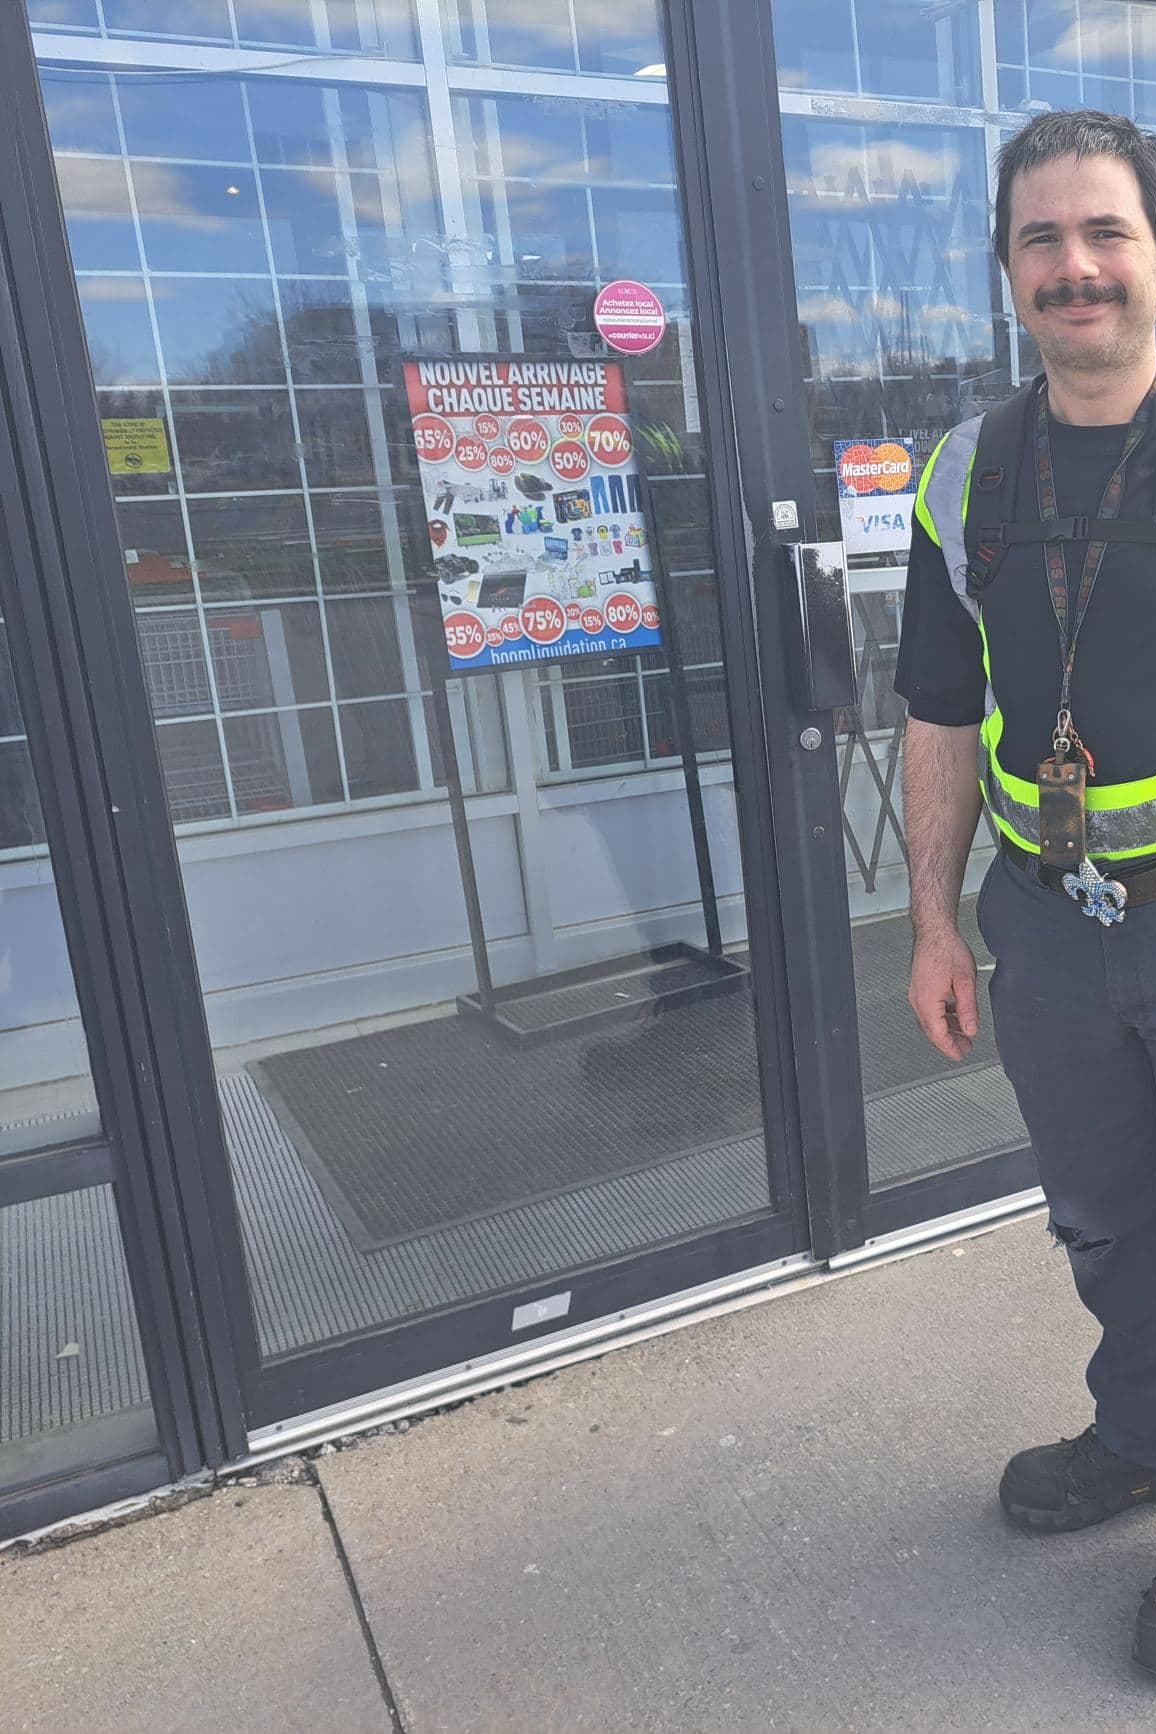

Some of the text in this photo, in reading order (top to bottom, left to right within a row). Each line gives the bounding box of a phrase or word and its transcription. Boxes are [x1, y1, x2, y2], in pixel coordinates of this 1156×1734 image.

[600, 307, 658, 315] Annoncez local
[602, 299, 653, 307] Achetez local
[418, 362, 607, 386] NOUVEL ARRIVAGE
[427, 387, 607, 413] CHAQUE SEMAINE
[477, 422, 497, 434] 15%
[561, 422, 581, 433] 30%
[415, 429, 450, 449] 65%
[509, 432, 546, 451] 60%
[589, 431, 629, 452] 70%
[458, 448, 486, 462] 25%
[490, 455, 513, 468] 80%
[554, 453, 586, 469] 50%
[842, 461, 909, 477] MasterCard
[857, 513, 905, 533] VISA
[525, 611, 561, 631] 75%
[583, 616, 602, 627] 15%
[607, 606, 638, 622] 80%
[503, 622, 520, 634] 45%
[446, 626, 481, 647] 55%
